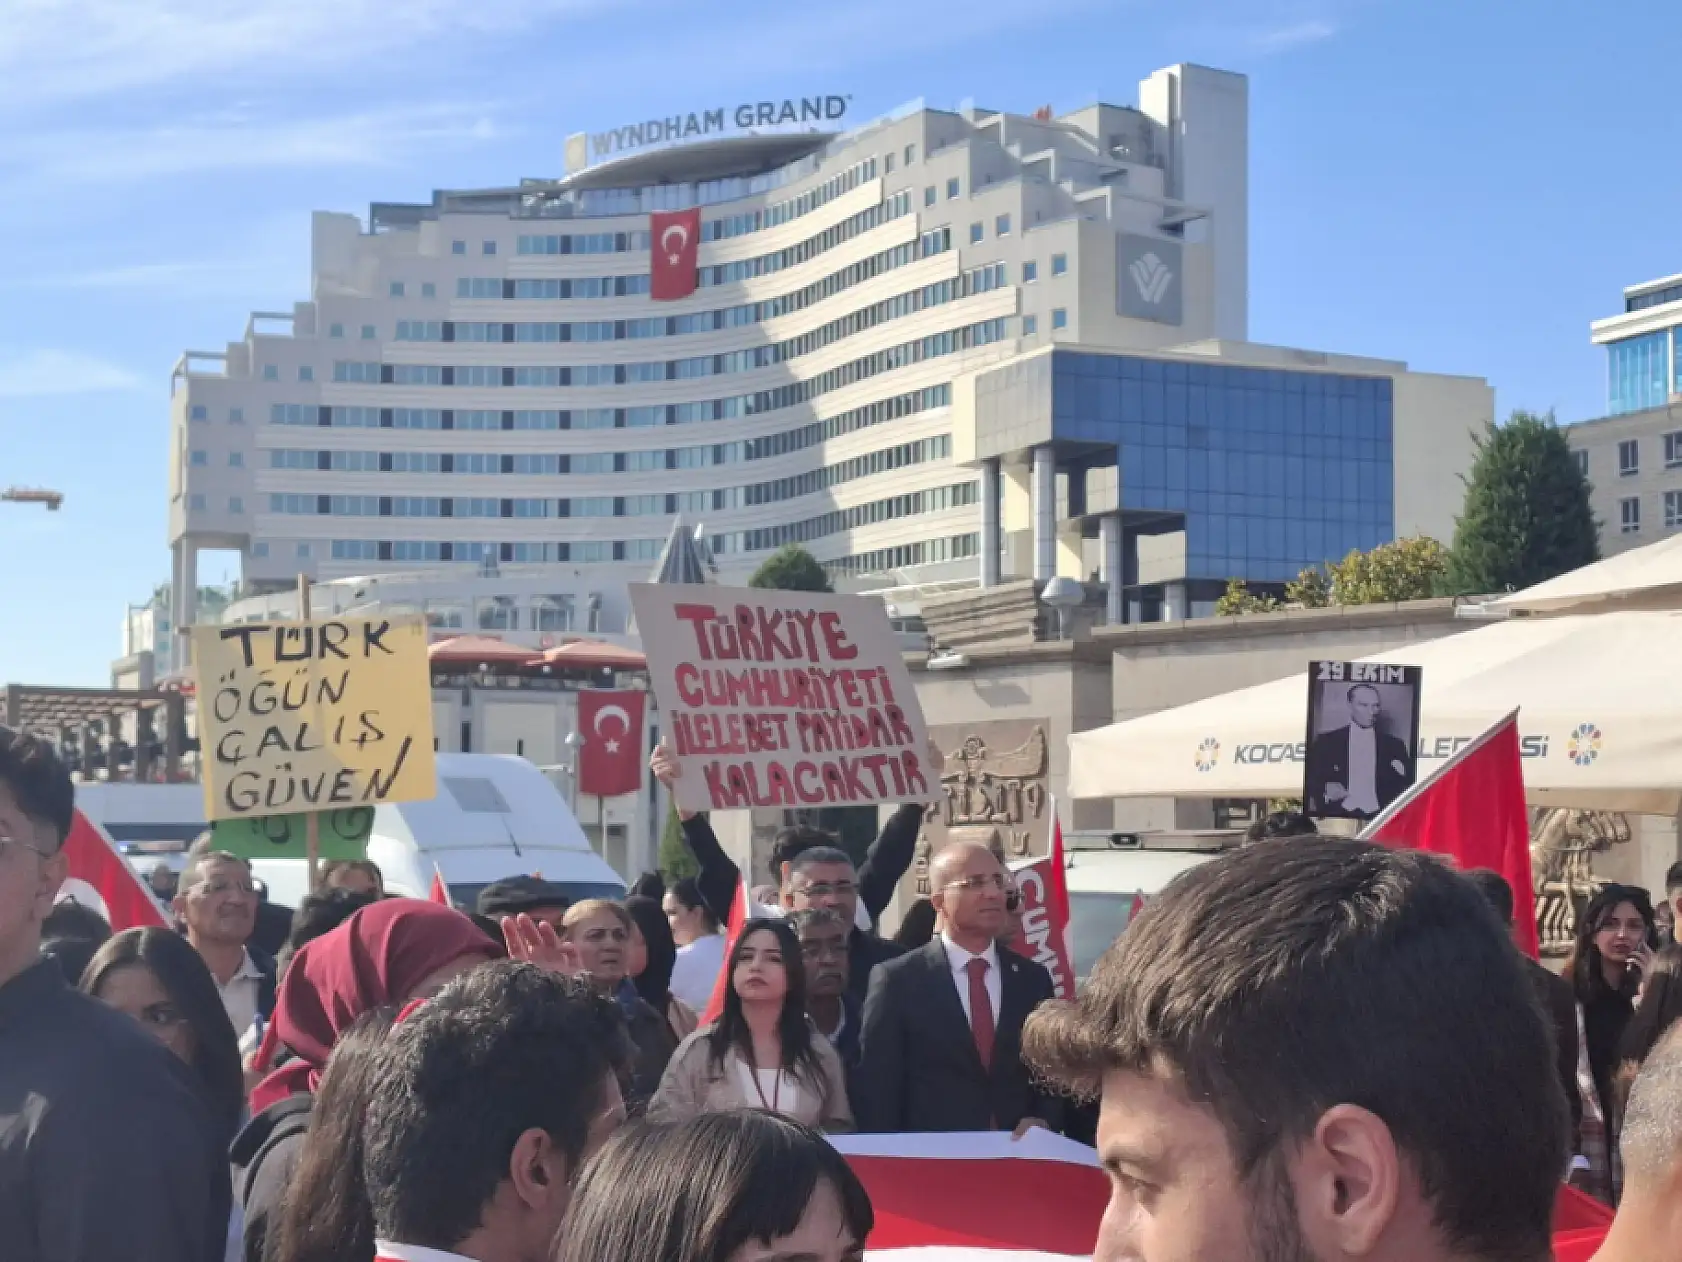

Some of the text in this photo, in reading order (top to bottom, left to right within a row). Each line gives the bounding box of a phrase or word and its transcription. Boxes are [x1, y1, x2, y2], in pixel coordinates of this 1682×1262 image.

[592, 95, 849, 155] WYNDHAM GRAND
[220, 620, 394, 667] TÜRK
[674, 603, 858, 662] TÜRKİYE
[214, 668, 350, 723] ÖĞÜN
[675, 662, 895, 709] CUMHURİYETİ
[216, 710, 384, 766] ÇALIŞ
[670, 704, 914, 756] İLELEBET PAYİDAR
[1234, 743, 1306, 764] KOCAS
[225, 736, 413, 811] GÜVEN
[703, 750, 929, 809] KALACAKTIR
